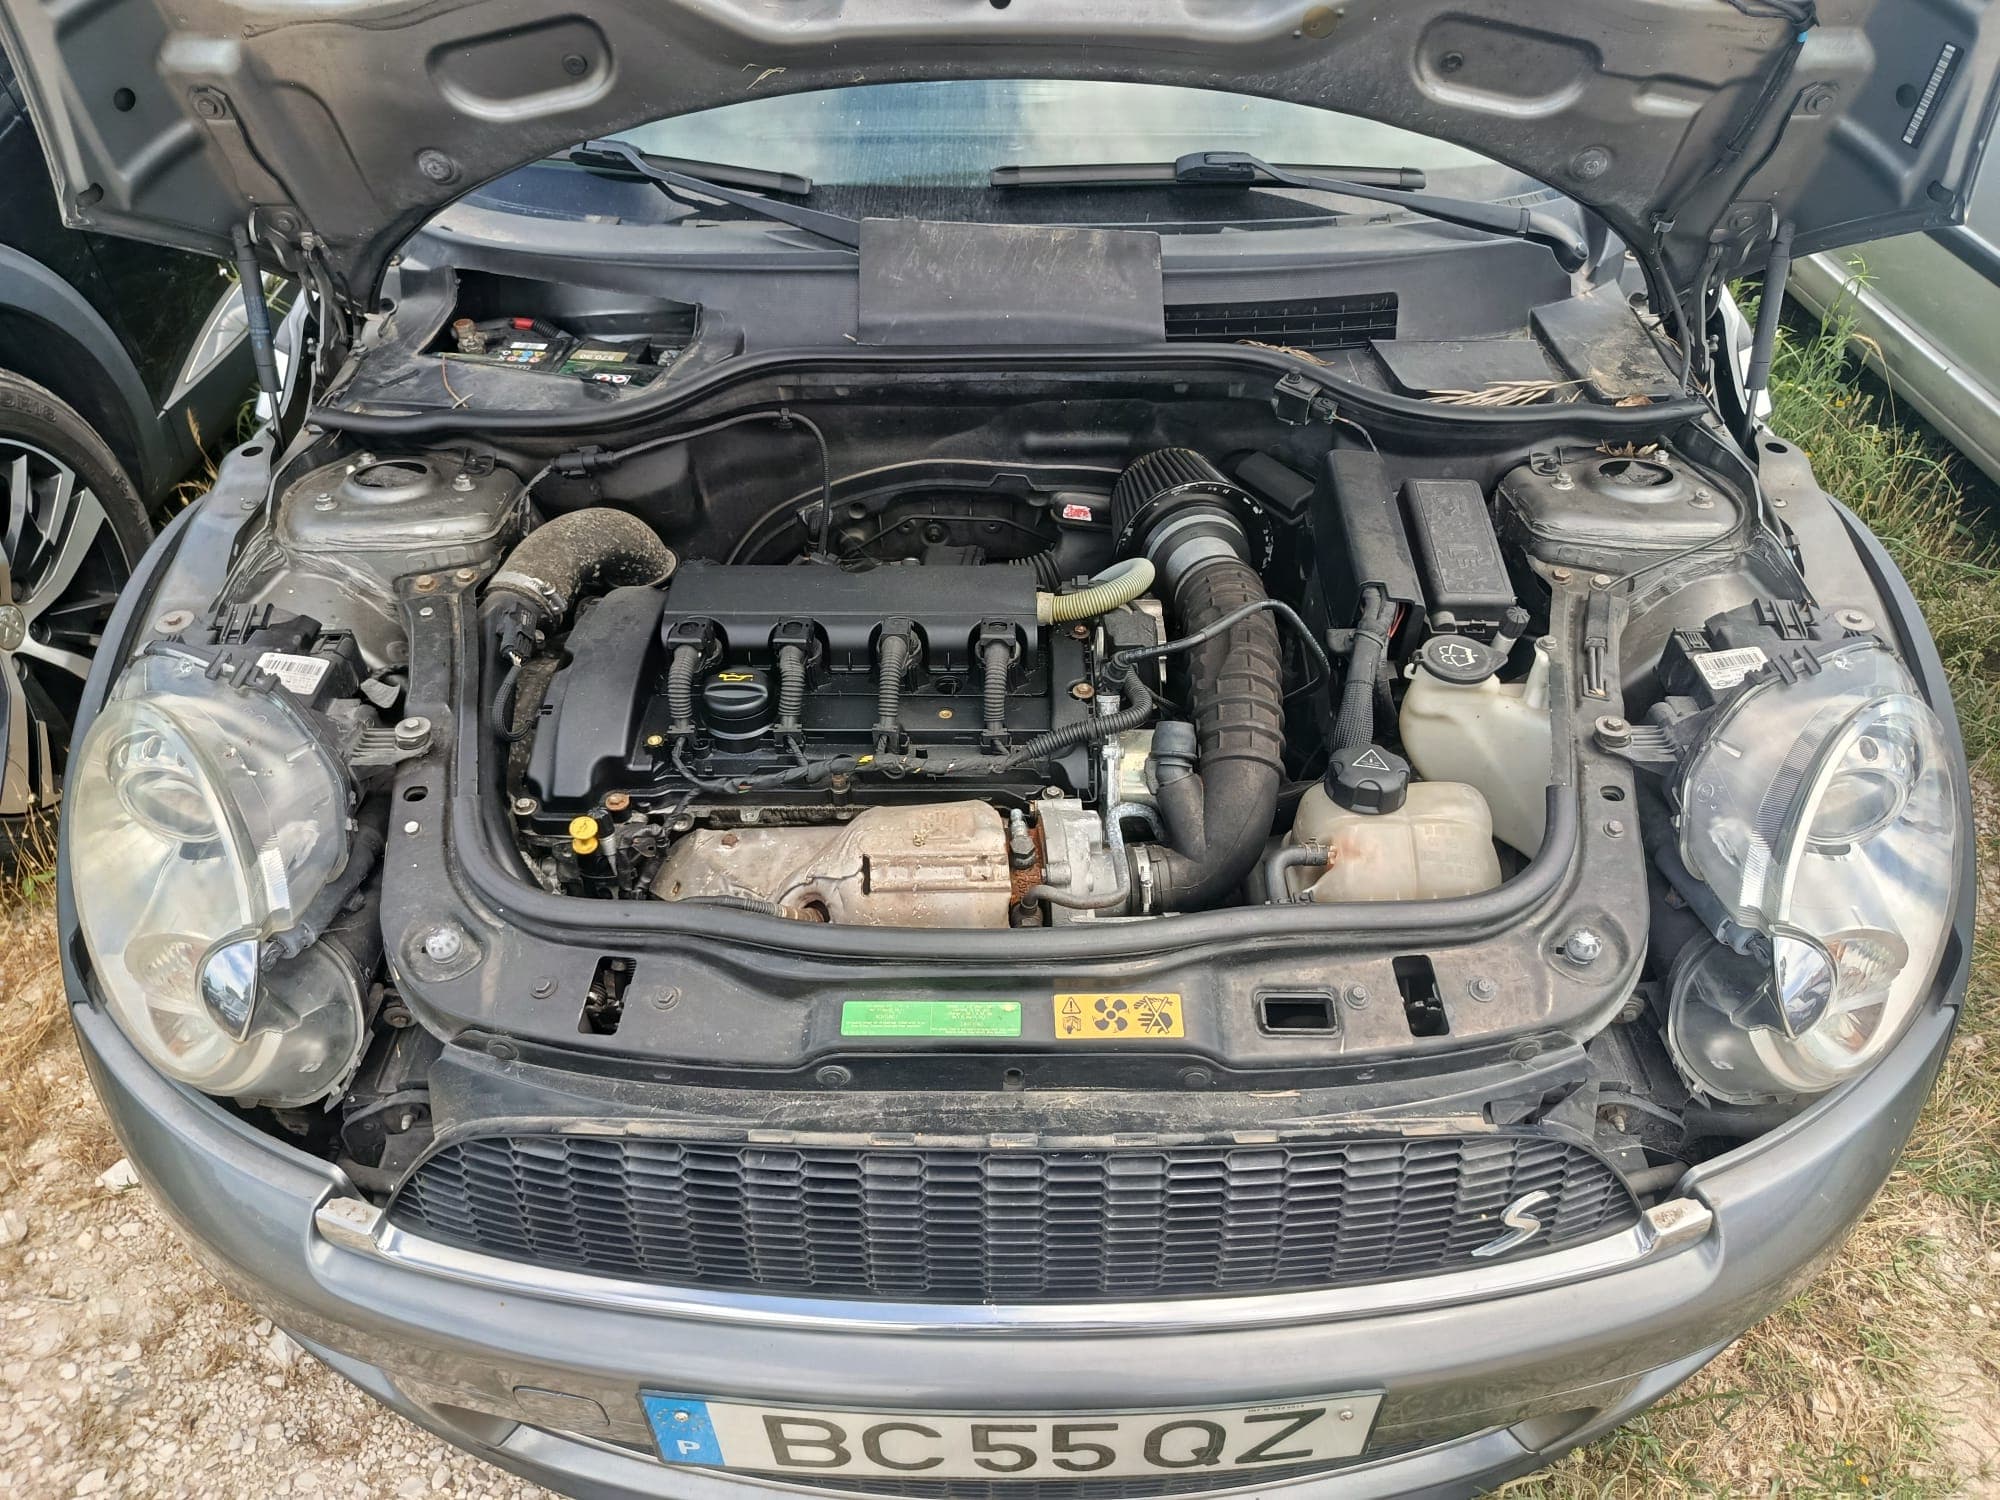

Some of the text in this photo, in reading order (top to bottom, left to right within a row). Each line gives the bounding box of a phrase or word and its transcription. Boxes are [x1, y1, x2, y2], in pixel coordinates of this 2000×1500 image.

[1471, 1190, 1550, 1256] S
[676, 1440, 700, 1454] P
[763, 1408, 1326, 1472] BC 55 QZ
